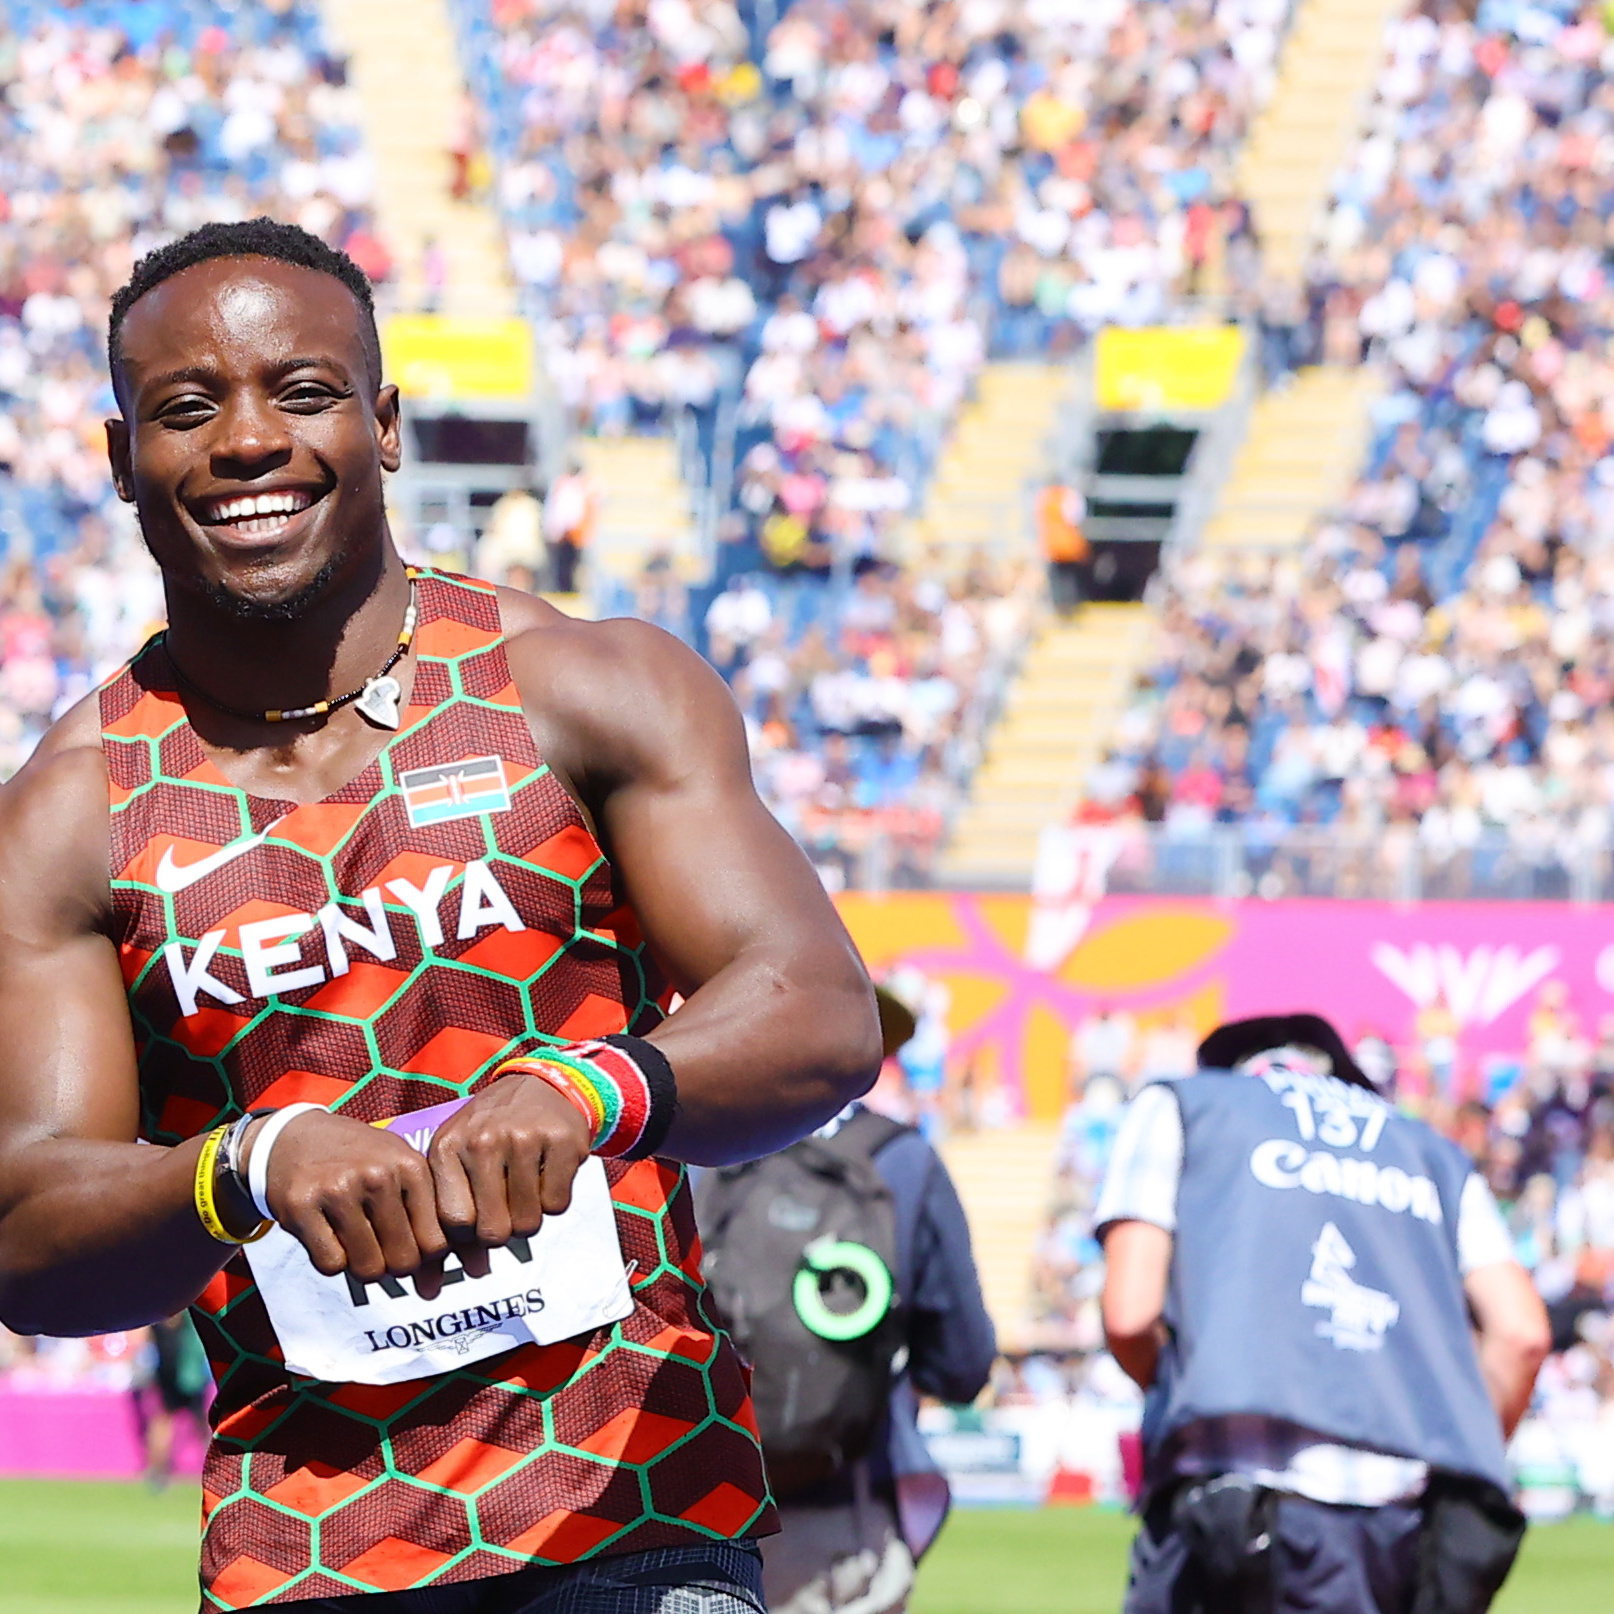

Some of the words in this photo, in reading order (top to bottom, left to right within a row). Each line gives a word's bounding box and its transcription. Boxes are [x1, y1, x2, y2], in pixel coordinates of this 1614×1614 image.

[164, 860, 526, 1017] KENYA
[1281, 1088, 1389, 1152] 137
[1248, 1138, 1443, 1226] Canon
[364, 1288, 547, 1351] LONGINES
